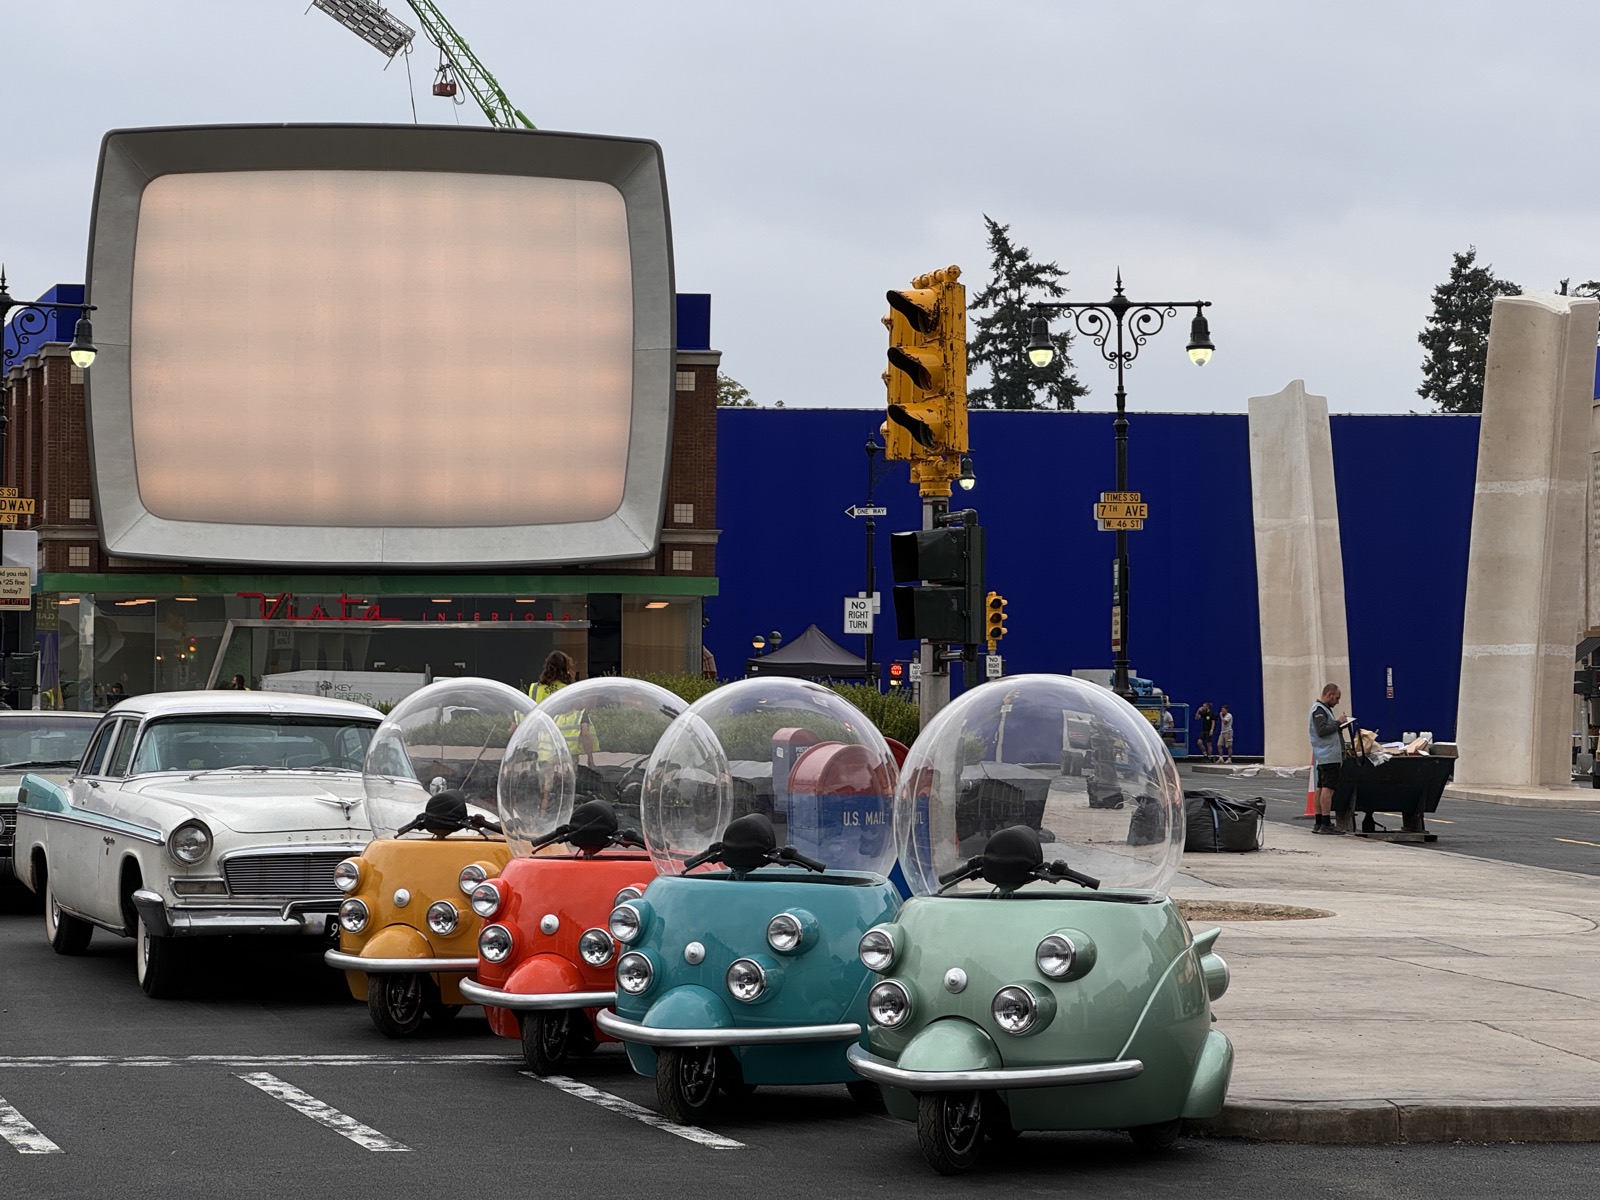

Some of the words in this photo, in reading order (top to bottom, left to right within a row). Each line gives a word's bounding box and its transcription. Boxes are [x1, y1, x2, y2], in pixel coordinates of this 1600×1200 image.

[1, 500, 32, 511] DWAY
[1100, 505, 1117, 516] 7TH
[1125, 505, 1145, 516] AVE
[1105, 520, 1115, 528] W.
[1116, 520, 1127, 528] 46
[1130, 520, 1140, 528] ST
[236, 592, 402, 621] Vista
[422, 612, 571, 622] INTERIORS
[851, 601, 867, 610] NO
[848, 610, 870, 619] RIGHT
[849, 620, 868, 629] TURN
[334, 683, 354, 692] KEY
[333, 691, 373, 701] GREENS
[843, 811, 861, 826] U.S.
[865, 811, 886, 825] MAIL
